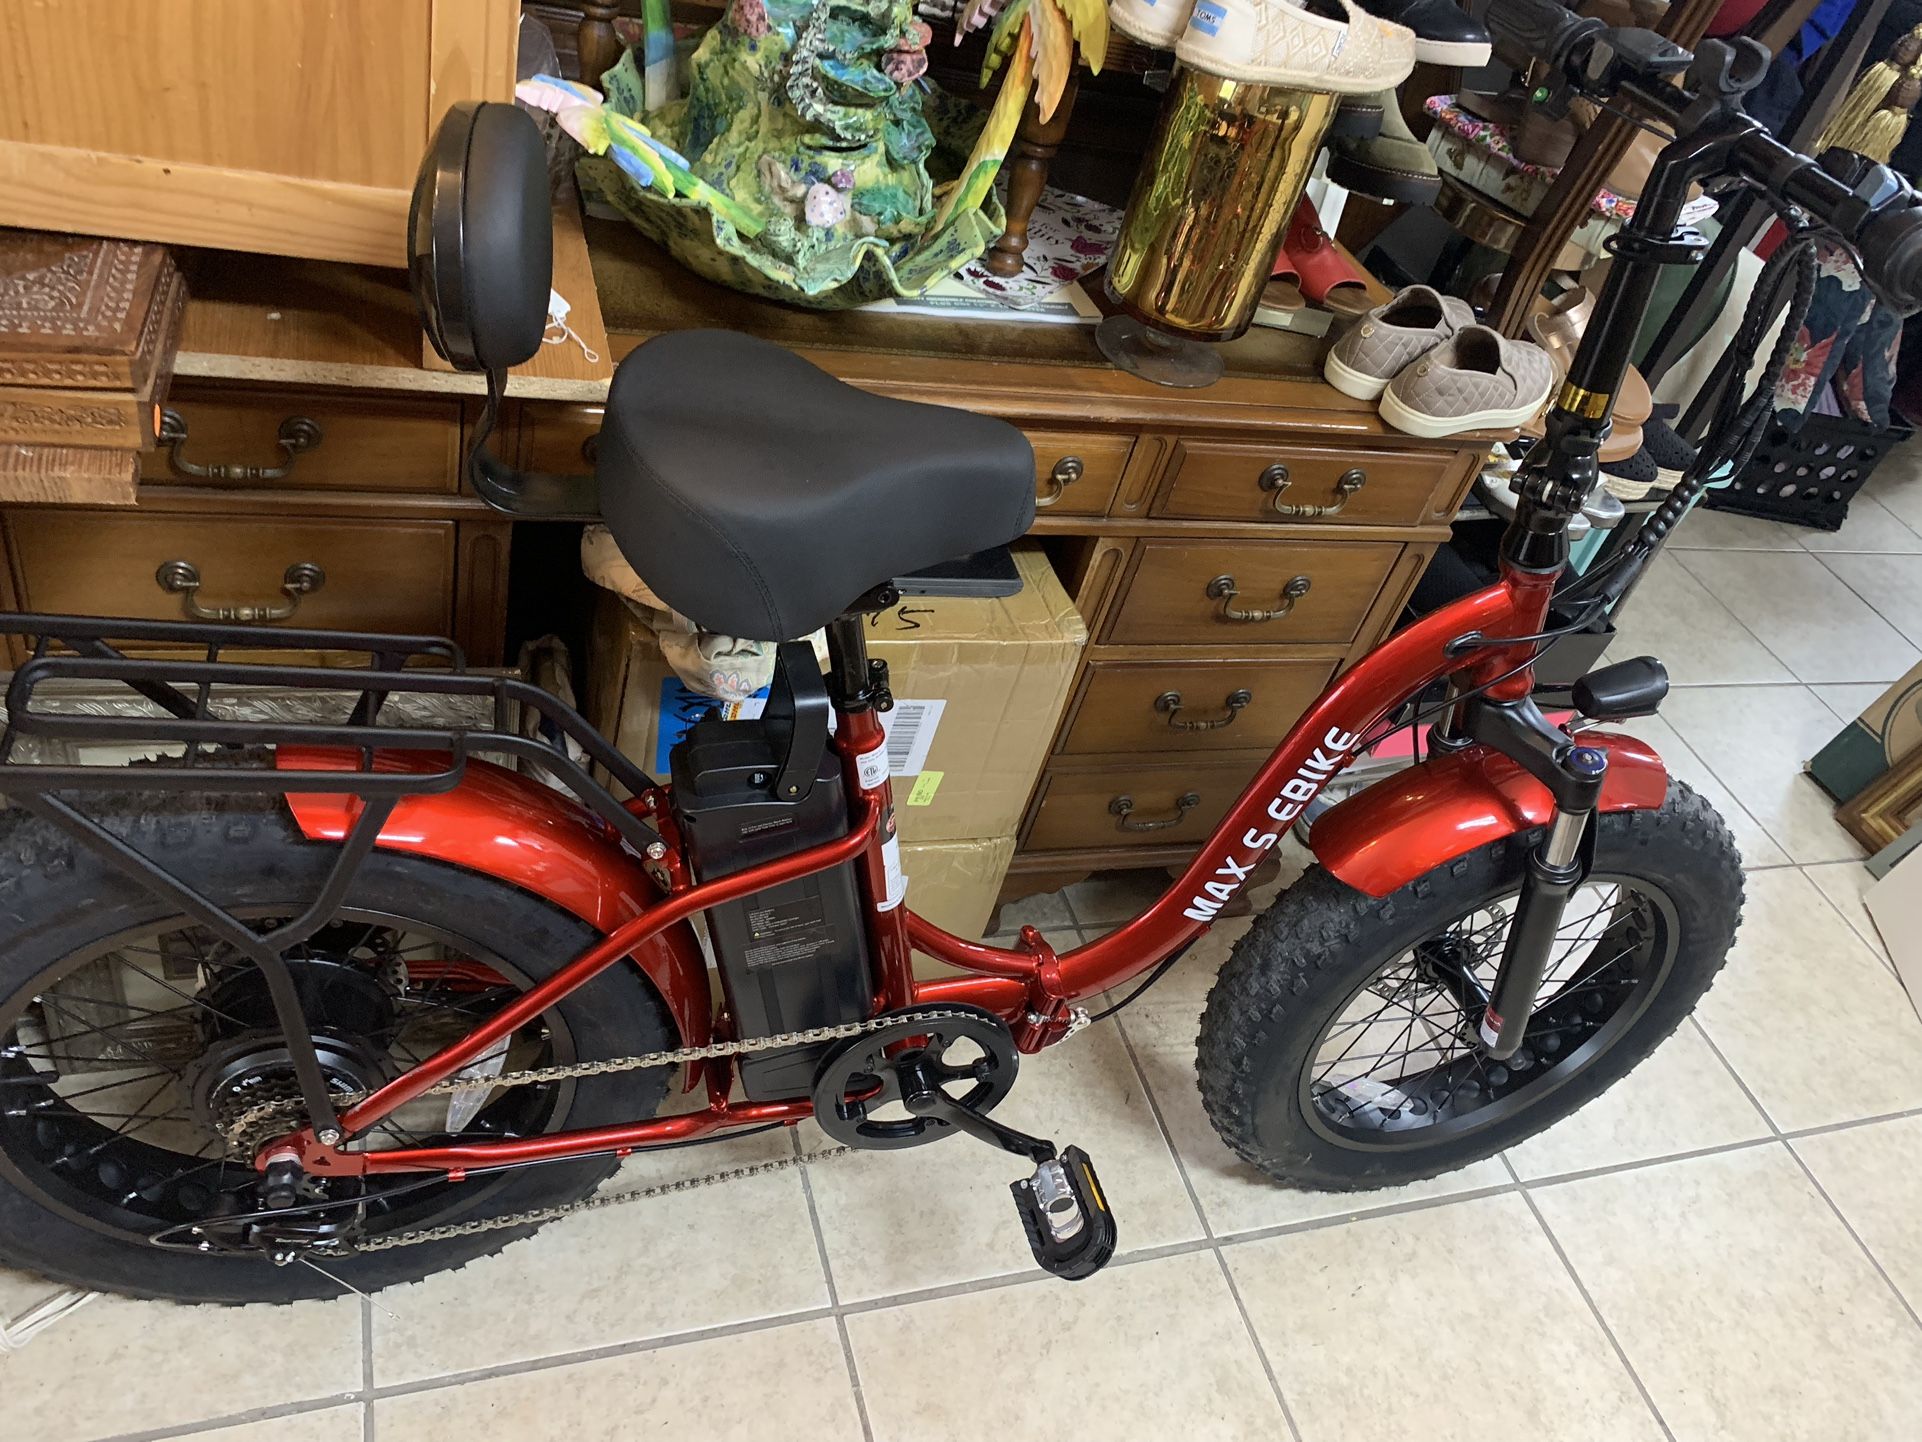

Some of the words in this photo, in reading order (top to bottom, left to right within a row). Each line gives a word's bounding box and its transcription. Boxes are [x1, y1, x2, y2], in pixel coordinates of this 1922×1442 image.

[1196, 9, 1216, 24] TOMS
[1183, 856, 1256, 922] MAX
[1243, 828, 1278, 850] S
[1267, 726, 1360, 821] EBIKE
